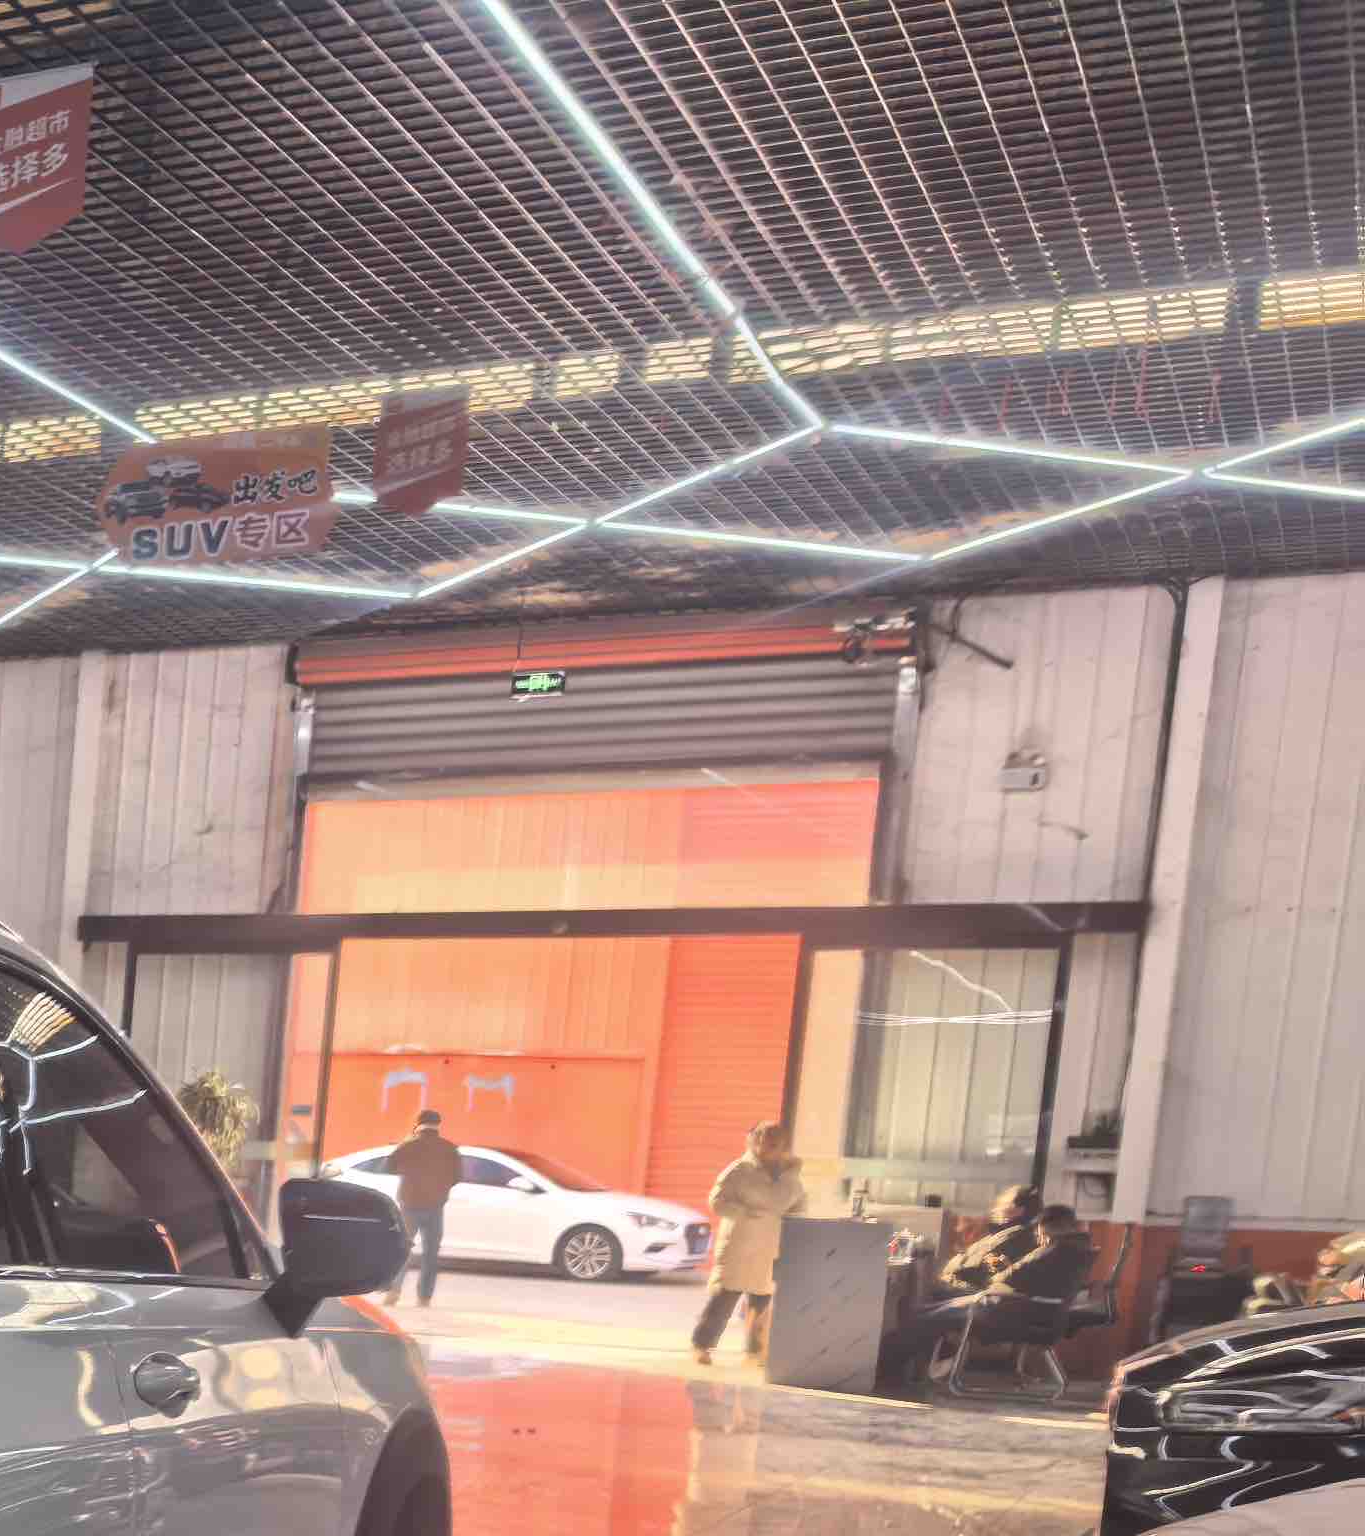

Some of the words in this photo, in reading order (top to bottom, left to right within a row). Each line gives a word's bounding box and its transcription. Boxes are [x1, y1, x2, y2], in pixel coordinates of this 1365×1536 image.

[231, 468, 319, 505] 出发吧
[130, 508, 310, 561] SUV专区
